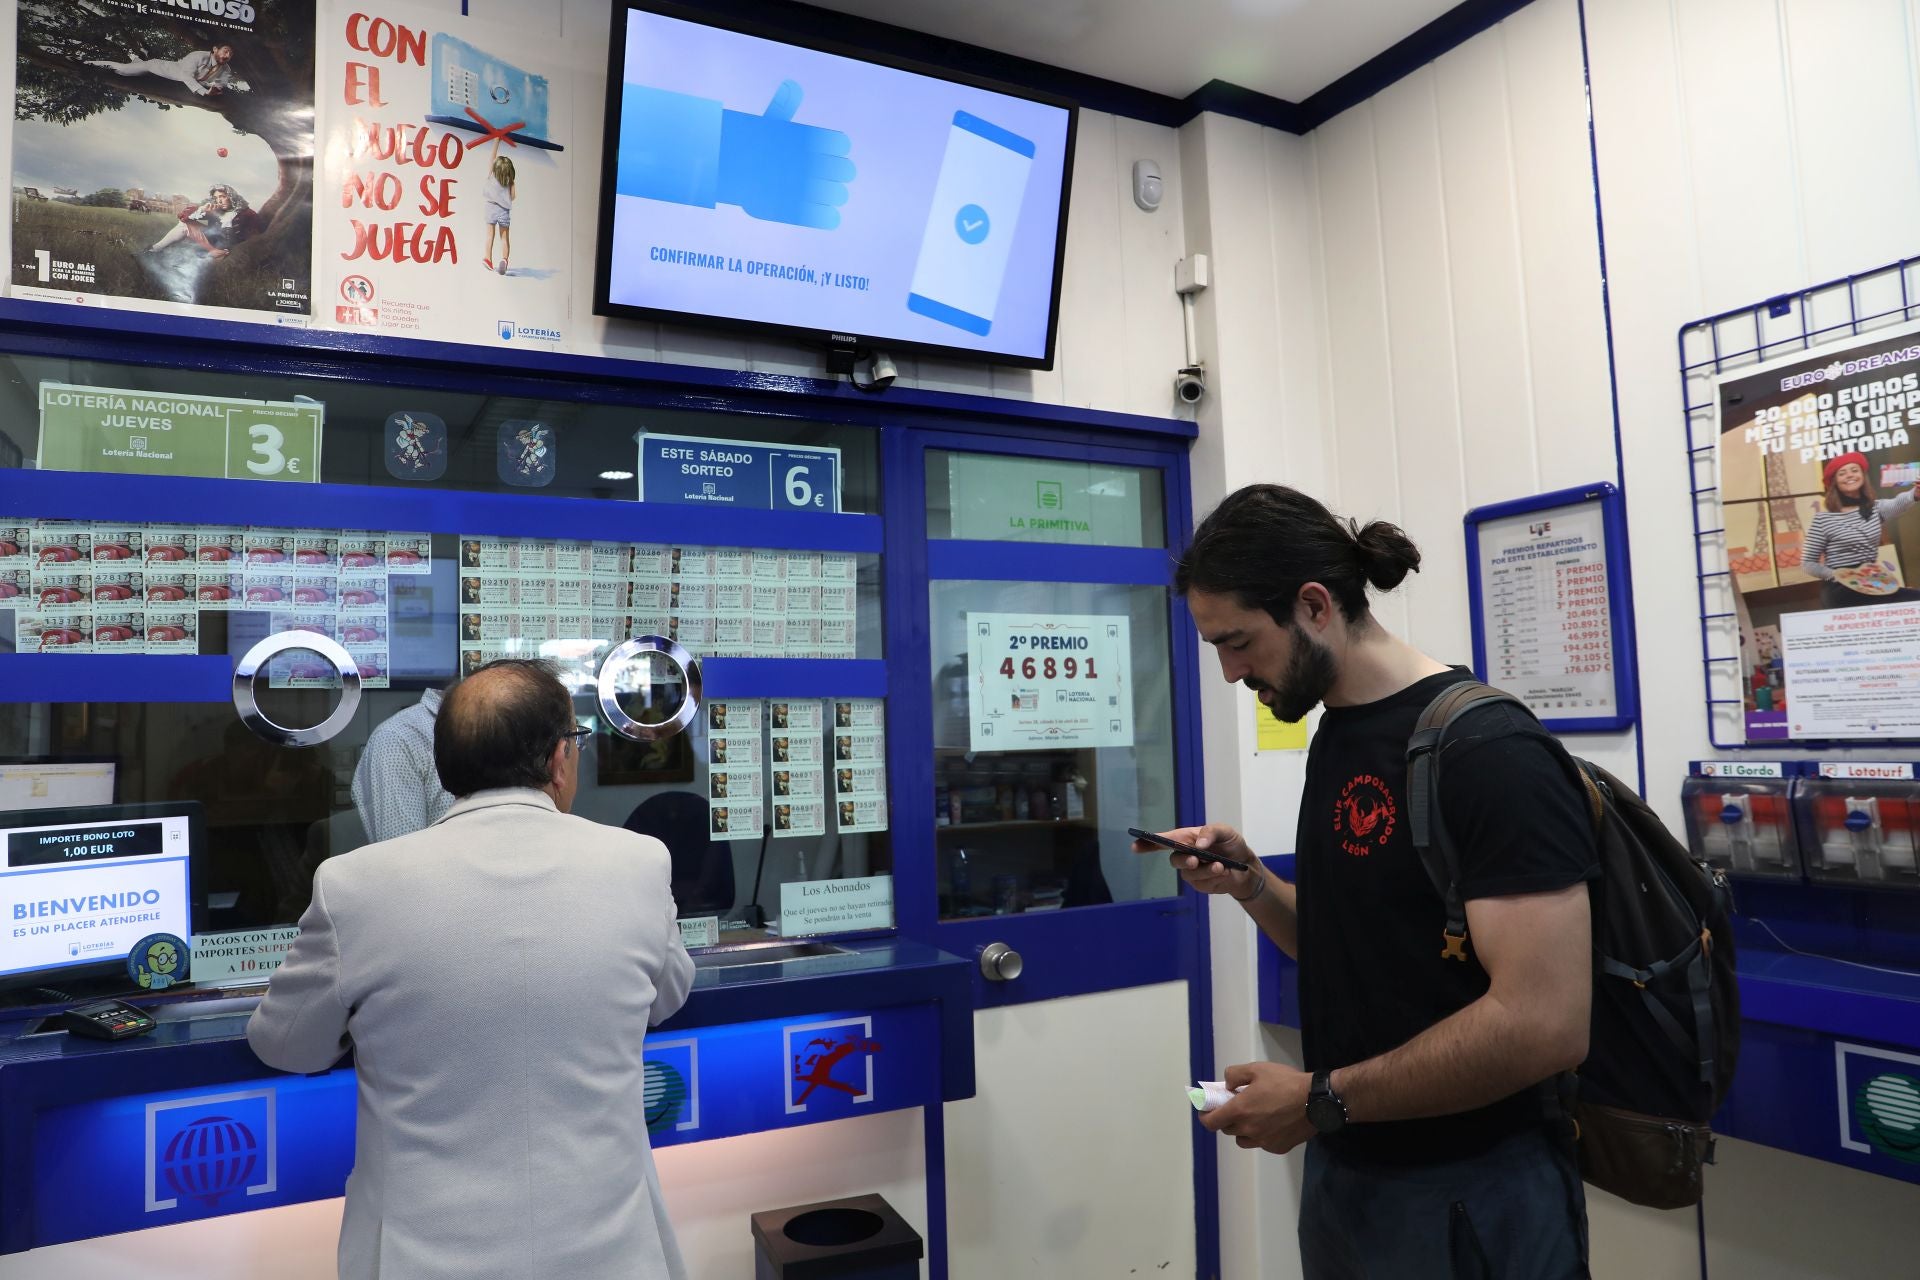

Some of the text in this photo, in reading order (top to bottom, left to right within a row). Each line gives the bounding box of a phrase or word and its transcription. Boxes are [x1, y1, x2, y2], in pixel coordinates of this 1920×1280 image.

[229, 24, 253, 32] HISTORIA
[346, 12, 426, 66] CON
[344, 62, 389, 108] EL
[342, 172, 458, 218] NO SE
[340, 219, 457, 264] JUEGA
[52, 261, 95, 272] EURO MÁS
[650, 246, 870, 291] CONFIRMAR LA OPERACIÓN, ¡Y LISTO!
[71, 275, 95, 283] JOKER
[381, 300, 414, 308] Recuerda
[518, 328, 560, 338] LOTERÍAS
[831, 334, 856, 343] PHILIPS
[1782, 348, 1920, 390] EURO DREAMS
[46, 392, 225, 418] LOTERÍA NACIONAL
[1754, 373, 1918, 425] 20.000 EUROS
[101, 414, 172, 431] JUEVES
[1744, 406, 1850, 443] MES PARA
[1757, 437, 1785, 456] TU
[1870, 412, 1903, 433] DE
[1801, 428, 1909, 464] PINTORA
[103, 448, 173, 459] Lotería Nacional
[661, 448, 753, 464] ESTE SÁBADO
[681, 464, 733, 477] SORTEO
[708, 494, 734, 502] Nacional
[1010, 517, 1090, 532] LA PRIMITIVA
[1503, 537, 1583, 555] PREMIOS REPARTIDOS
[1508, 554, 1525, 562] ESTE
[1528, 543, 1598, 559] ESTABLECIMIENTO
[1567, 563, 1604, 575] PREMIO
[1567, 575, 1604, 586] PREMIO
[1568, 586, 1605, 597] PREMIO
[1568, 597, 1606, 607] PREMIO
[1872, 608, 1916, 617] PREMIOS
[1838, 620, 1882, 630] APUESTAS
[1010, 636, 1088, 650] 2º PREMIO
[1723, 765, 1774, 776] El Gordo
[1848, 766, 1903, 776] Lototurf
[1342, 774, 1396, 845] CAMPOSAGRADO
[39, 830, 135, 845] IMPORTE BONO LOTO
[63, 844, 114, 857] 1,00 EUR
[1342, 840, 1369, 856] LEÓN
[802, 882, 871, 896] Los Abonados
[14, 889, 160, 920] BIENVENIDO
[784, 909, 797, 917] Que
[806, 906, 827, 915] jueves
[847, 902, 866, 911] hayan
[13, 912, 160, 937] ES UN PLACER ATENDERLE
[83, 942, 114, 950] LOTERÍAS
[201, 936, 240, 946] PAGOS
[243, 933, 268, 943] CON
[195, 947, 255, 959] IMPORTES
[228, 965, 235, 973] A
[241, 960, 256, 972] 10
